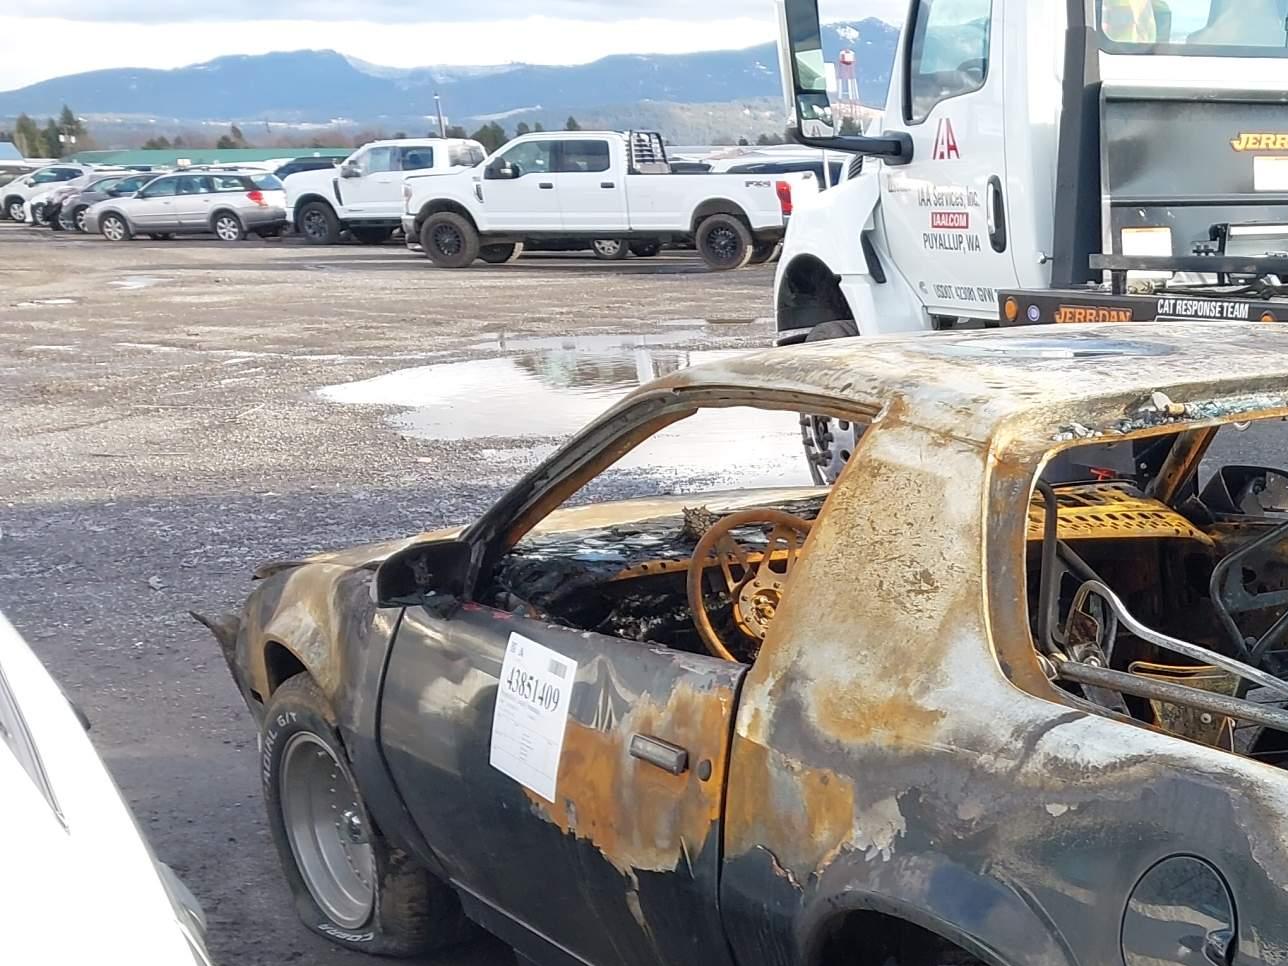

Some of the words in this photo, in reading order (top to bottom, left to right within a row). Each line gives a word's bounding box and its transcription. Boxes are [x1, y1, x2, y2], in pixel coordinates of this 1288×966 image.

[918, 187, 932, 207] IAA
[966, 186, 980, 207] Inc.
[923, 233, 966, 254] PUYALLUP,
[967, 234, 981, 251] WA
[933, 284, 955, 299] USDOT
[1157, 299, 1174, 315] CAT
[1176, 300, 1222, 316] RESPONSE
[1222, 302, 1249, 319] TEAM
[507, 666, 560, 713] 43851409
